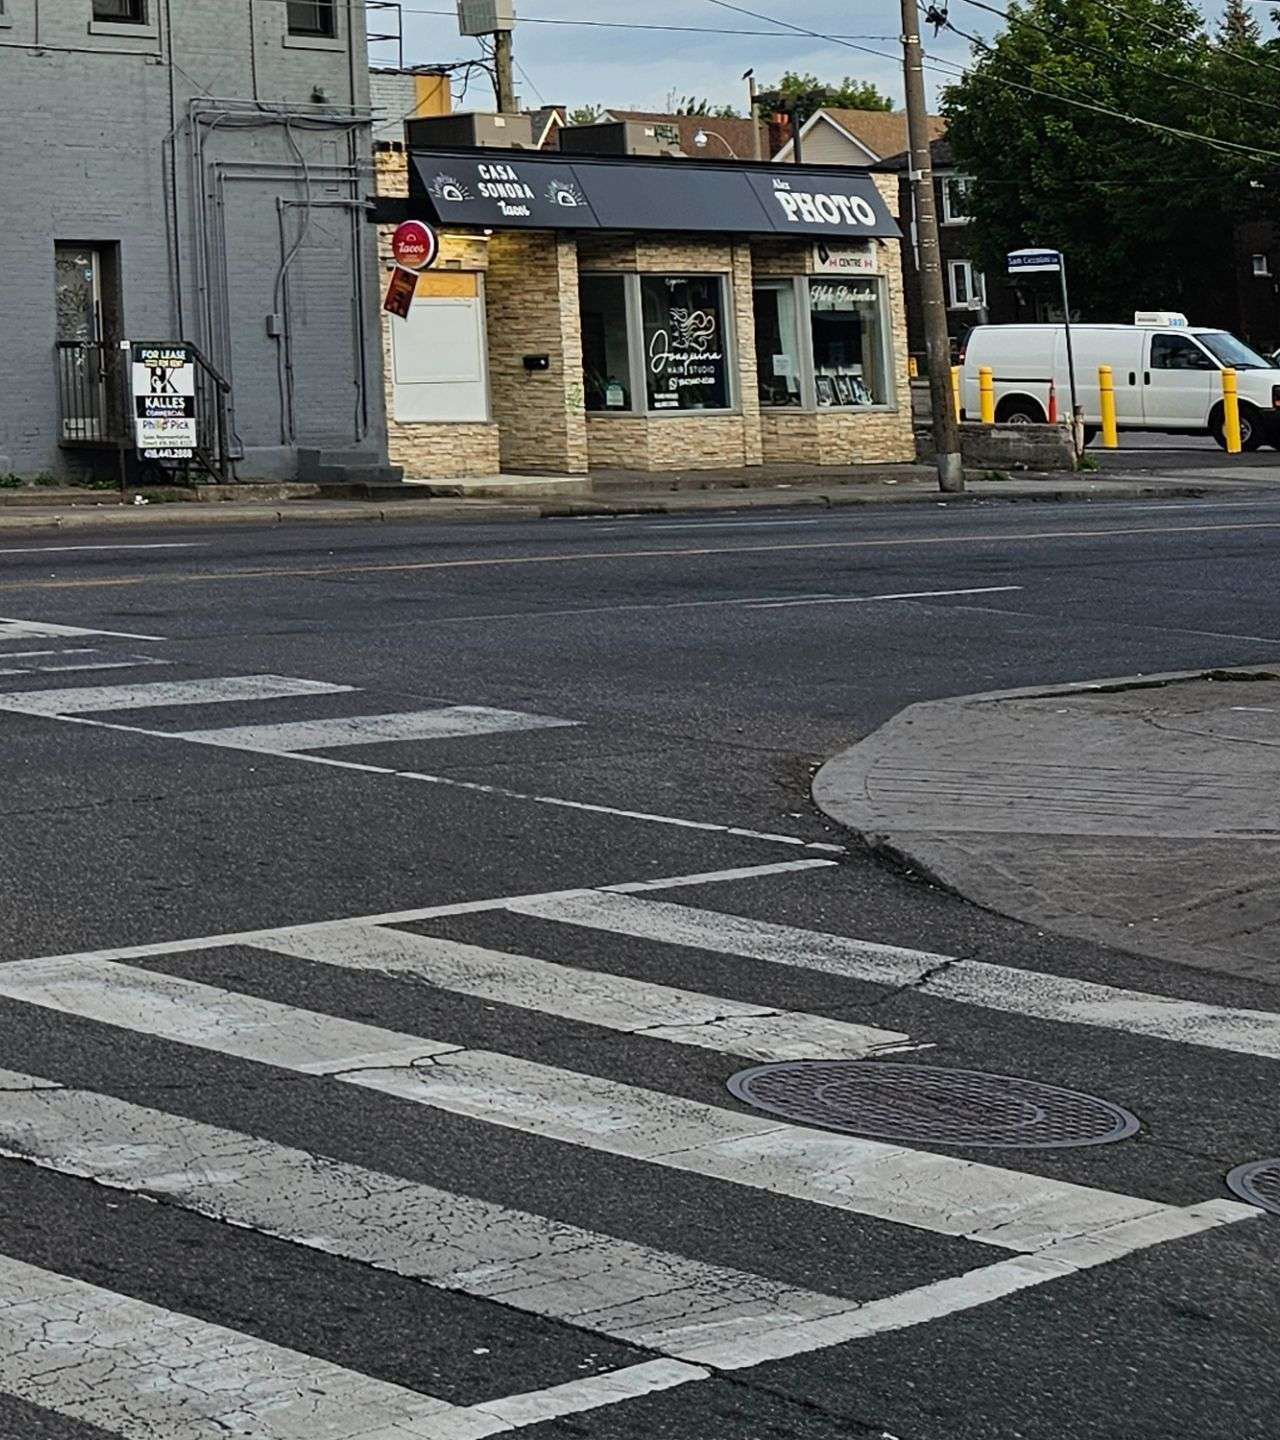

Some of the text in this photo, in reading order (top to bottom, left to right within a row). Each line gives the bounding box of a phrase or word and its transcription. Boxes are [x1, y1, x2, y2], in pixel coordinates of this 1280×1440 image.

[477, 164, 518, 181] CASA
[477, 182, 535, 200] SONORA
[774, 191, 876, 226] PHOTO
[142, 350, 186, 359] FOR LEASE
[667, 366, 715, 374] HAIR STUDIO
[145, 397, 185, 409] KALLES
